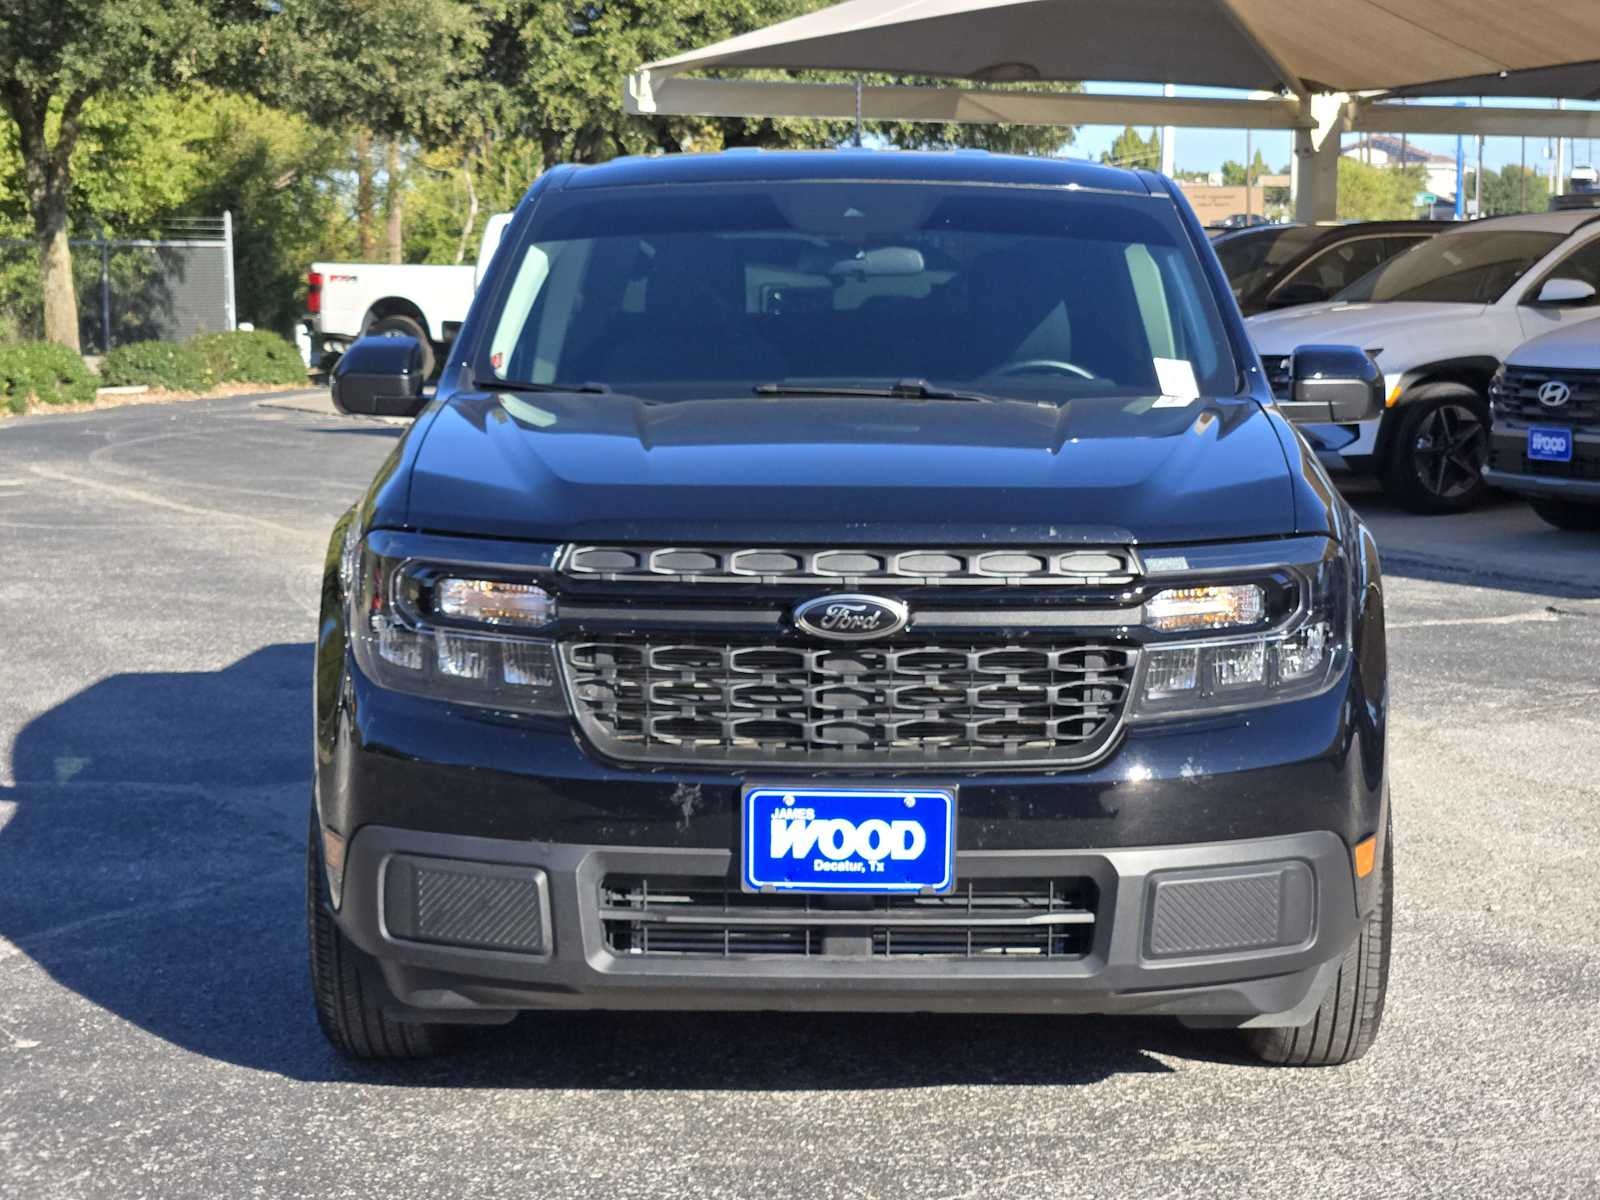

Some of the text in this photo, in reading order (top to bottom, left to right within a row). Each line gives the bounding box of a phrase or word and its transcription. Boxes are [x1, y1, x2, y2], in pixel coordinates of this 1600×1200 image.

[820, 603, 882, 629] Ford
[770, 808, 816, 820] JAMES
[770, 818, 927, 860] WOOD
[813, 859, 866, 873] Decatur,
